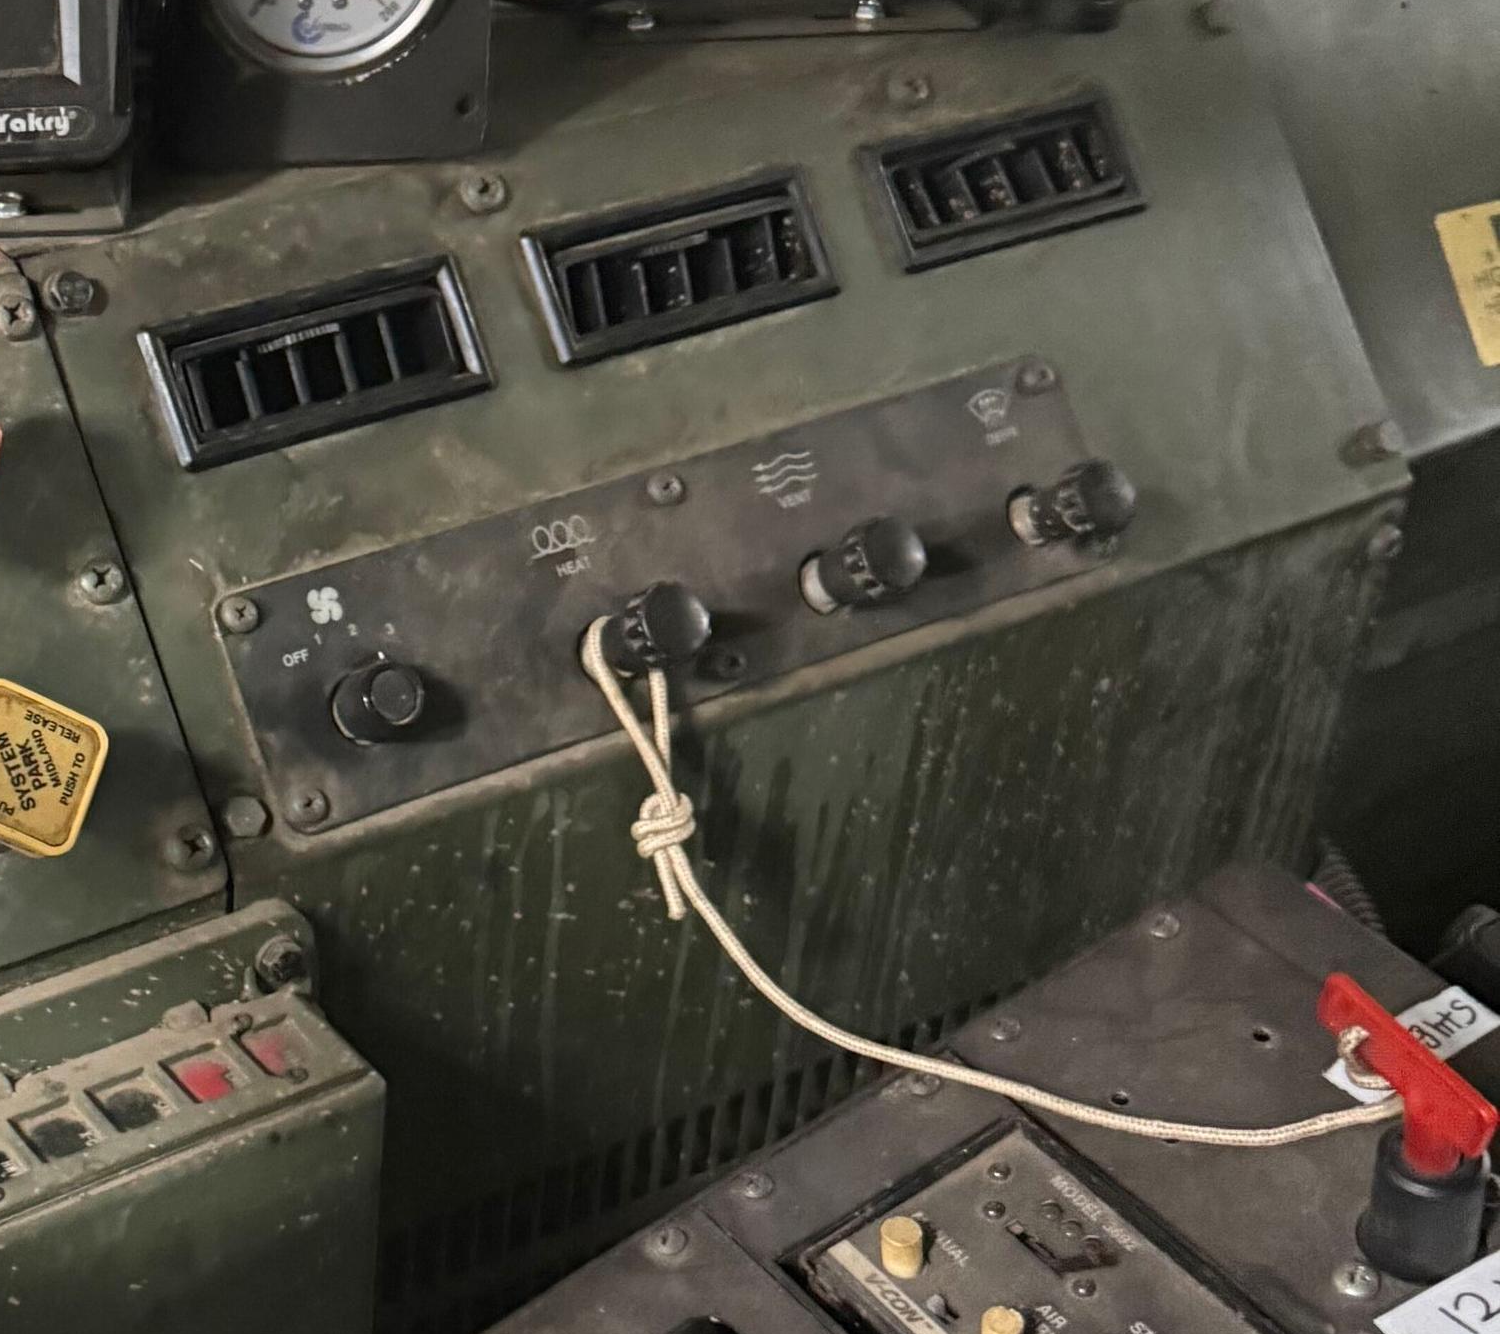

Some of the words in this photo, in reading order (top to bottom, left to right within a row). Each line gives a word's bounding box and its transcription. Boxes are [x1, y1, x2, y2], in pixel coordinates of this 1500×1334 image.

[556, 557, 591, 578] HEAT
[282, 648, 310, 667] OFF
[347, 622, 358, 637] 2
[383, 622, 395, 636] 3
[24, 709, 83, 744] RELEASE
[16, 738, 48, 791] PARK
[31, 729, 63, 788] MIDLAND
[59, 773, 78, 806] PUSH
[73, 752, 86, 771] TO
[1036, 1303, 1068, 1330] AIR
